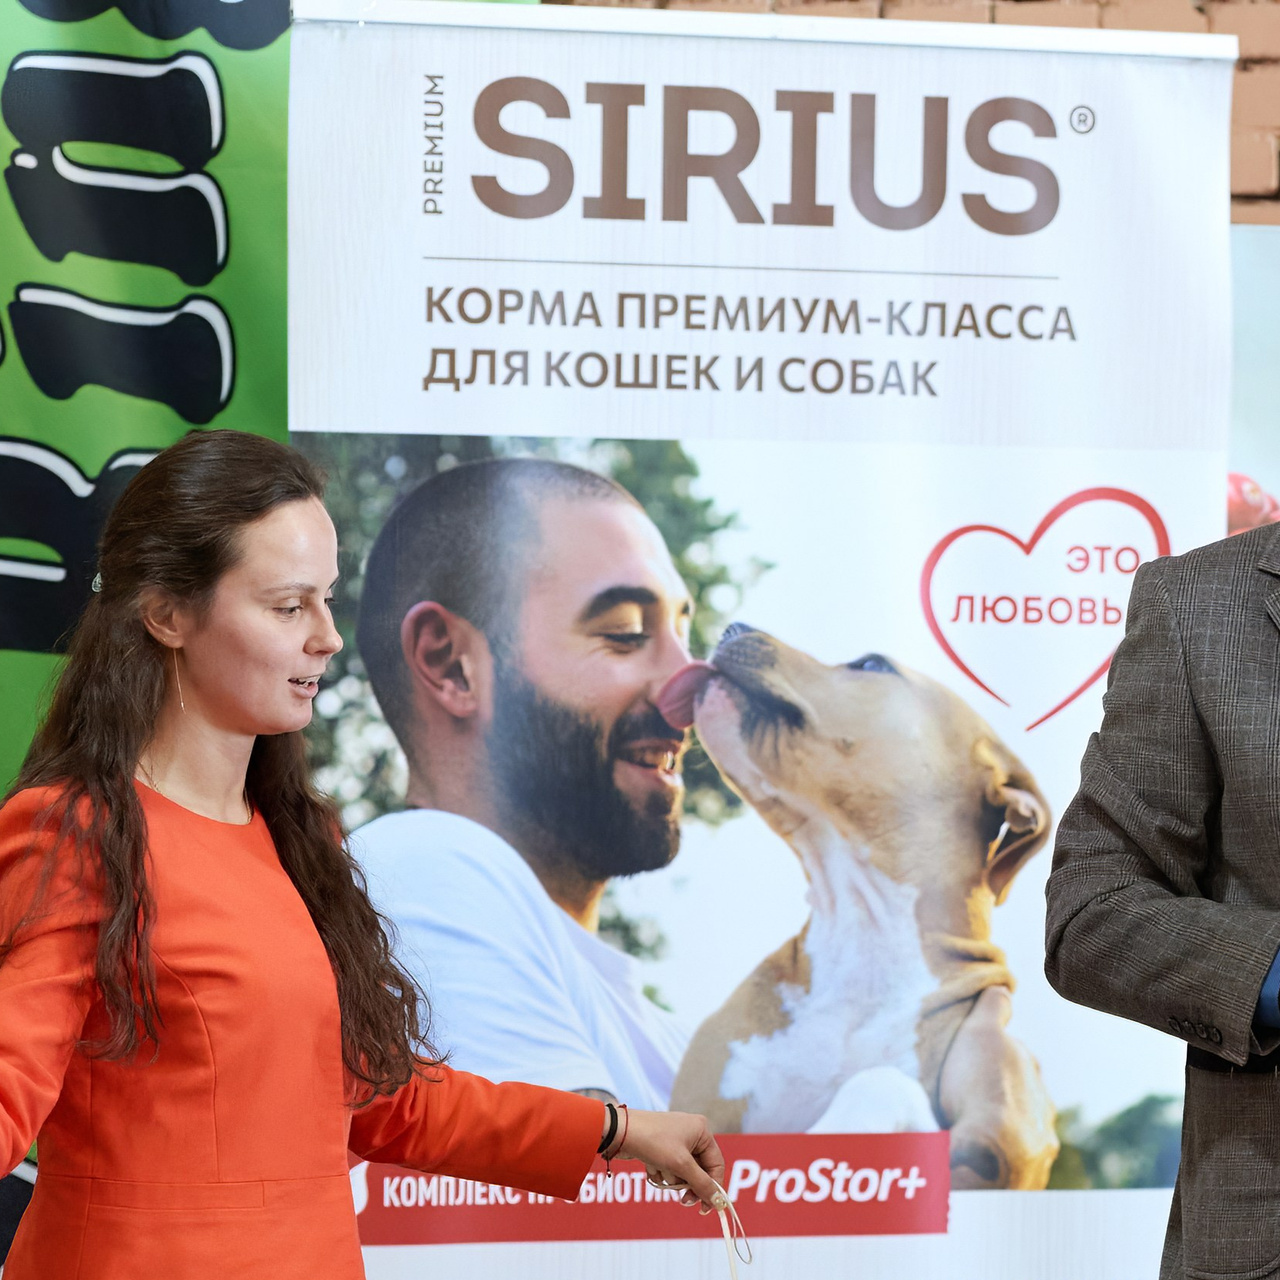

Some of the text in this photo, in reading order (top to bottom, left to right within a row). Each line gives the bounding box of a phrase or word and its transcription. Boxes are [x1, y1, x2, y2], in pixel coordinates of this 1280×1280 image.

[423, 74, 445, 215] PREMIUM
[470, 76, 1060, 236] SIRIUS
[425, 286, 1078, 341] КОРМА ПРЕМИУМ-КЛАССА
[422, 349, 938, 396] ДЛЯ КОШЕК И СОБАК
[1066, 545, 1140, 574] ЭТО
[950, 594, 1122, 624] ЛЮБОВЬ
[728, 1156, 928, 1204] ProStor+
